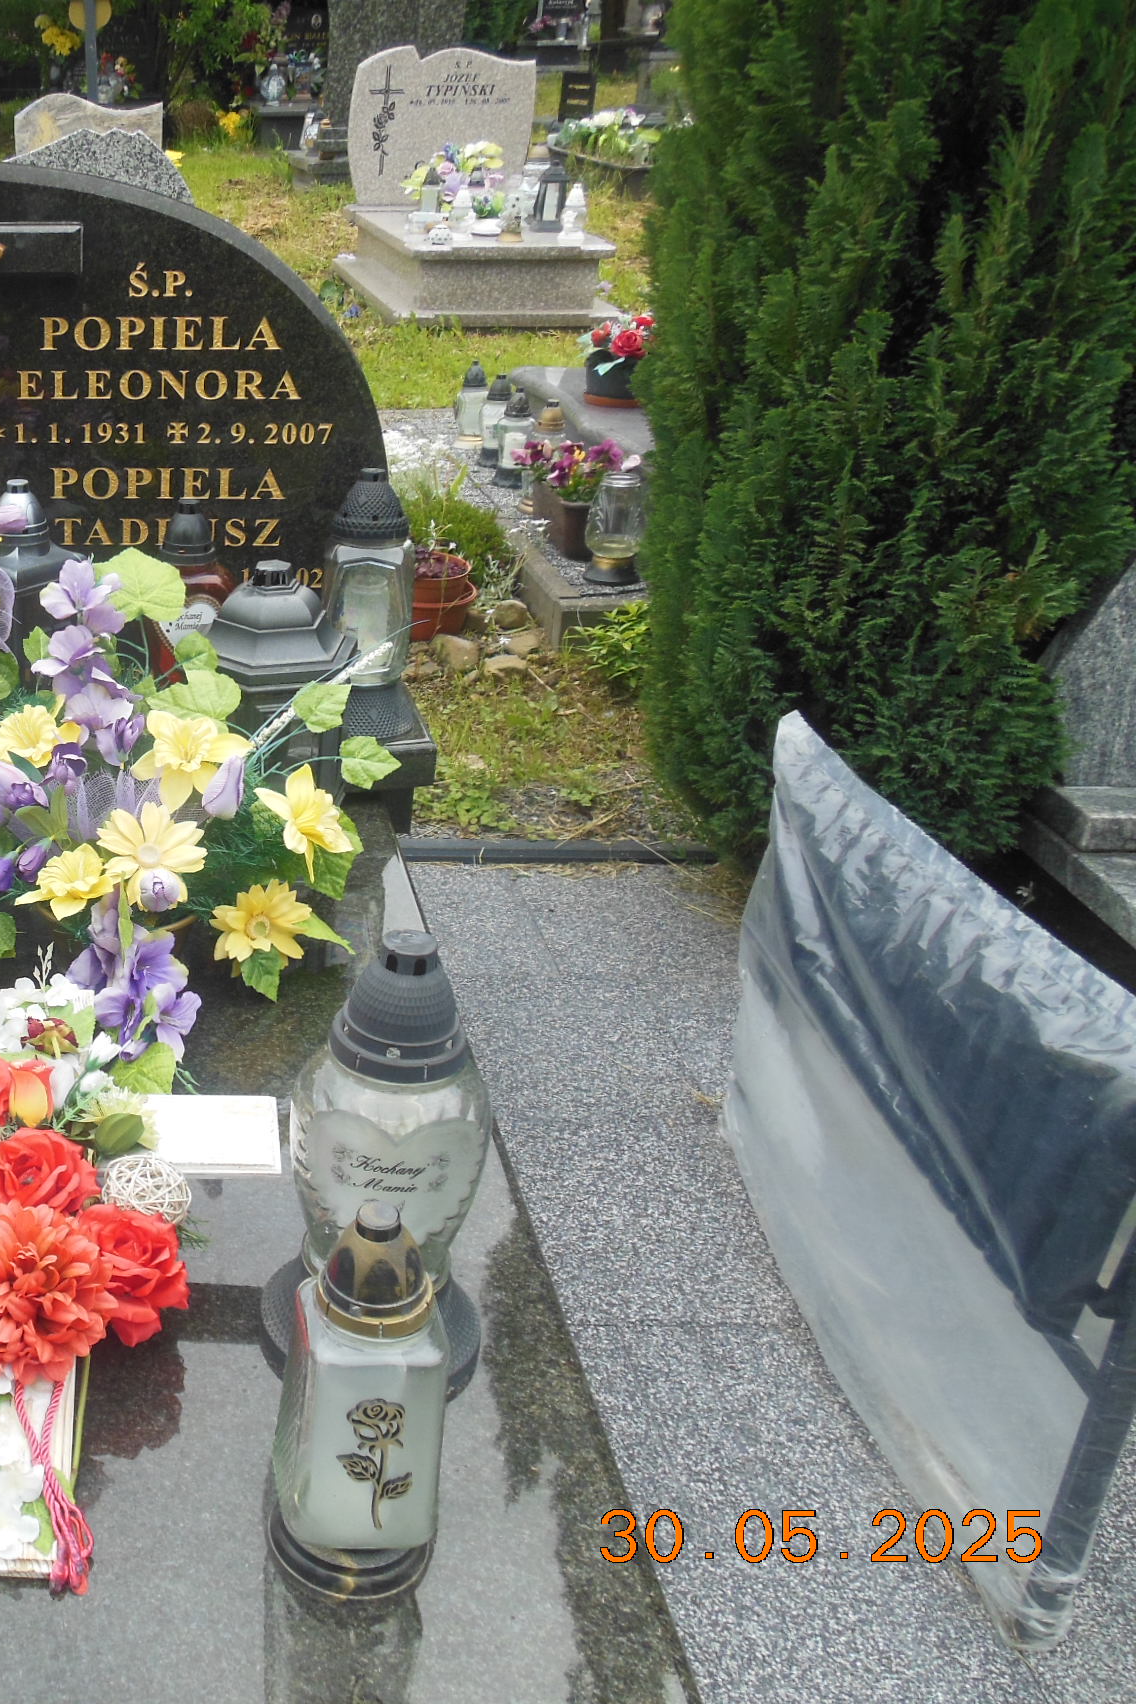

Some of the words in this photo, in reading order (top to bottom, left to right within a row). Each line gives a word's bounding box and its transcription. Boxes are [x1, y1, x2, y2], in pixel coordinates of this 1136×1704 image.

[426, 83, 496, 97] TYPIŃSKI
[127, 261, 194, 298] Ś.P.
[39, 315, 282, 351] POPIELA
[16, 369, 303, 401] ELEONORA
[49, 466, 287, 501] POPIELA
[353, 1177, 418, 1193] Mamie
